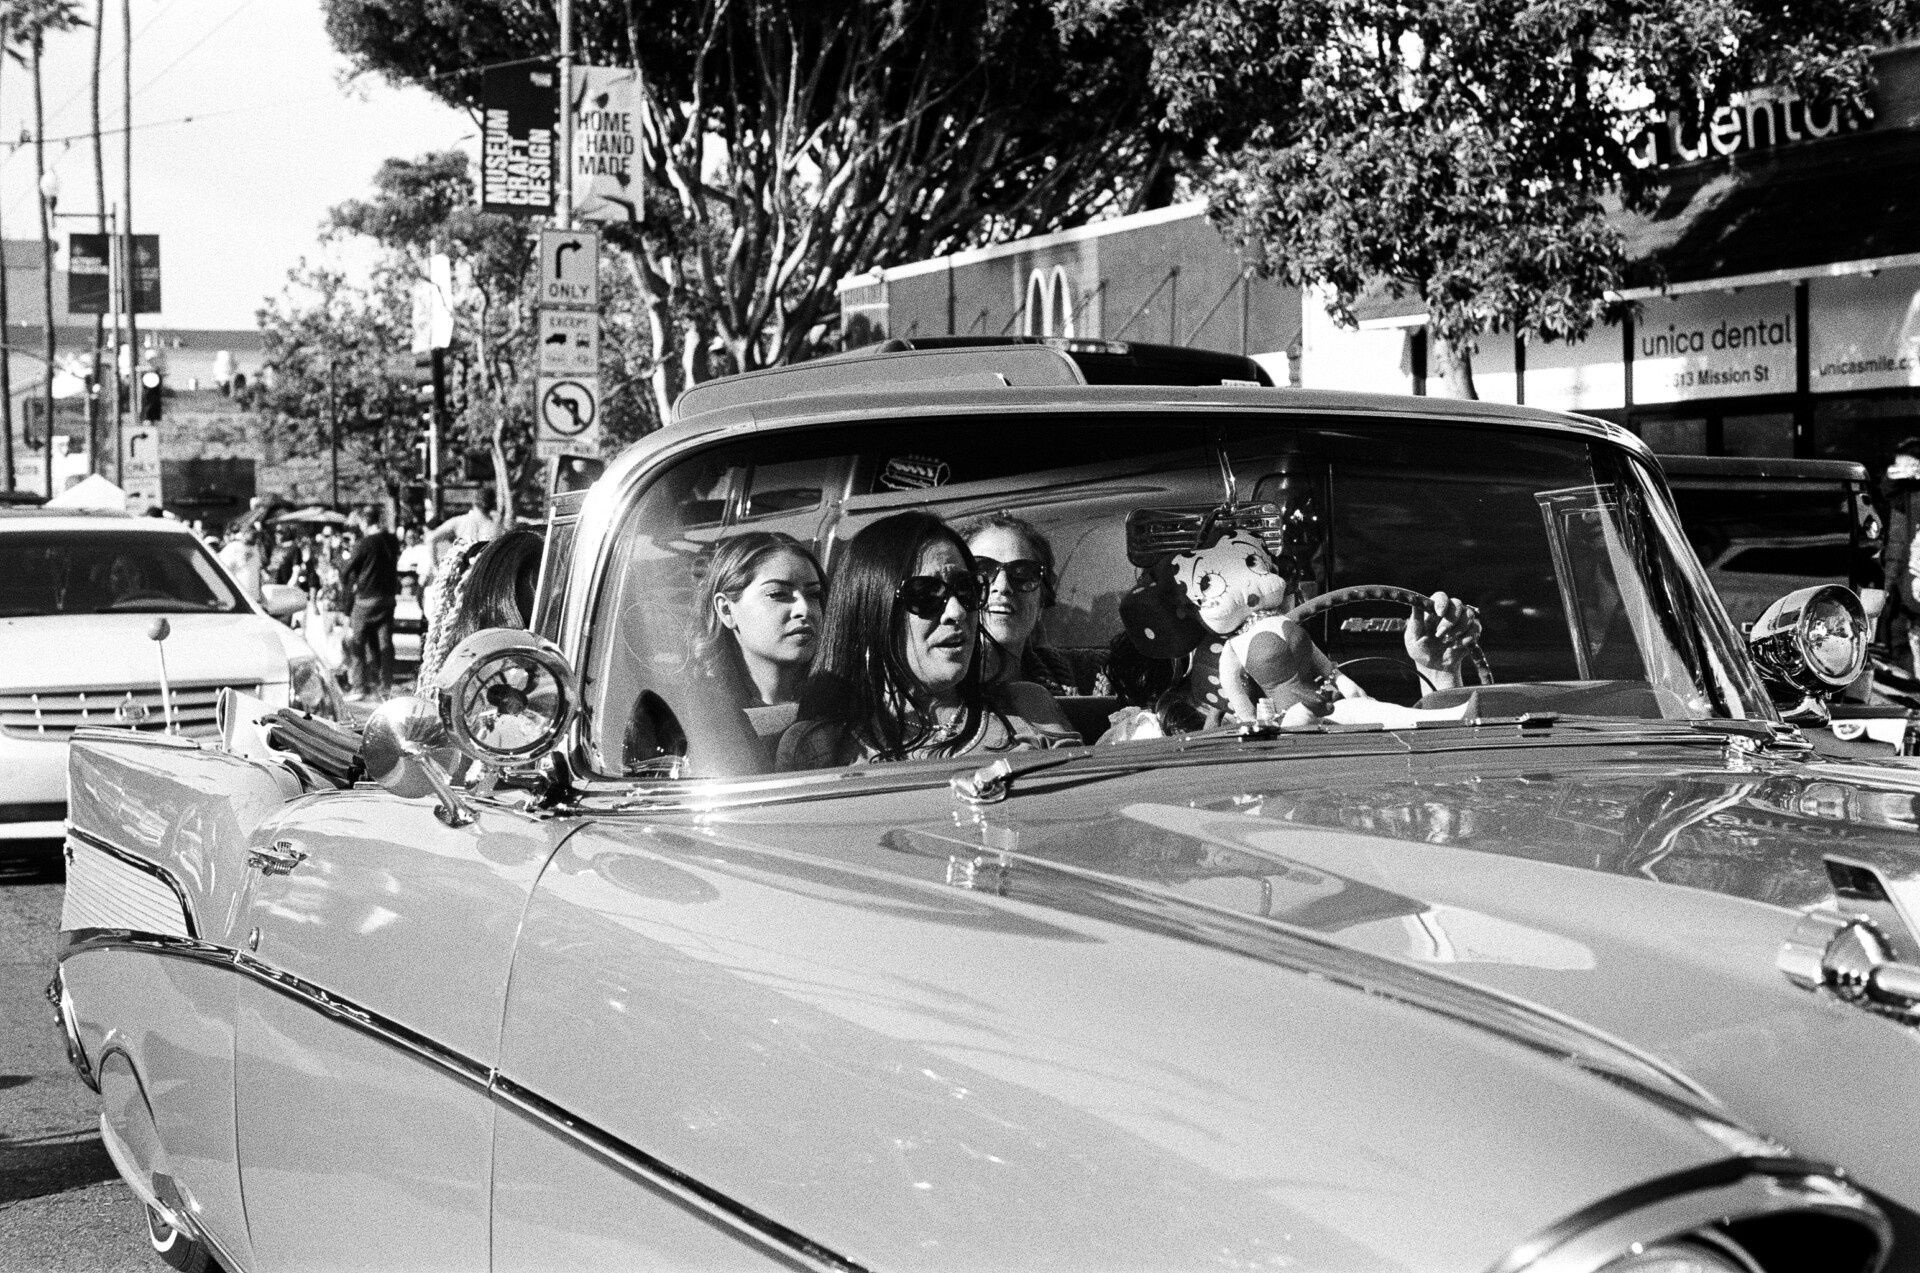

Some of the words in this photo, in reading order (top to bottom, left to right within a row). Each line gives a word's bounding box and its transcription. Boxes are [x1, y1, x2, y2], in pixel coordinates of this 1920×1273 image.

[578, 110, 631, 132] HOME
[586, 134, 634, 154] HAND
[485, 108, 508, 203] MUSEUM
[579, 155, 631, 175] MADE
[507, 135, 528, 205] CRAFT
[529, 128, 551, 206] DESIGN
[549, 282, 590, 298] ONLY
[1642, 324, 1704, 356] unica
[1712, 314, 1792, 350] dental
[1698, 367, 1750, 385] Mission
[1754, 364, 1769, 382] St
[1820, 356, 1914, 376] unicasmile.c
